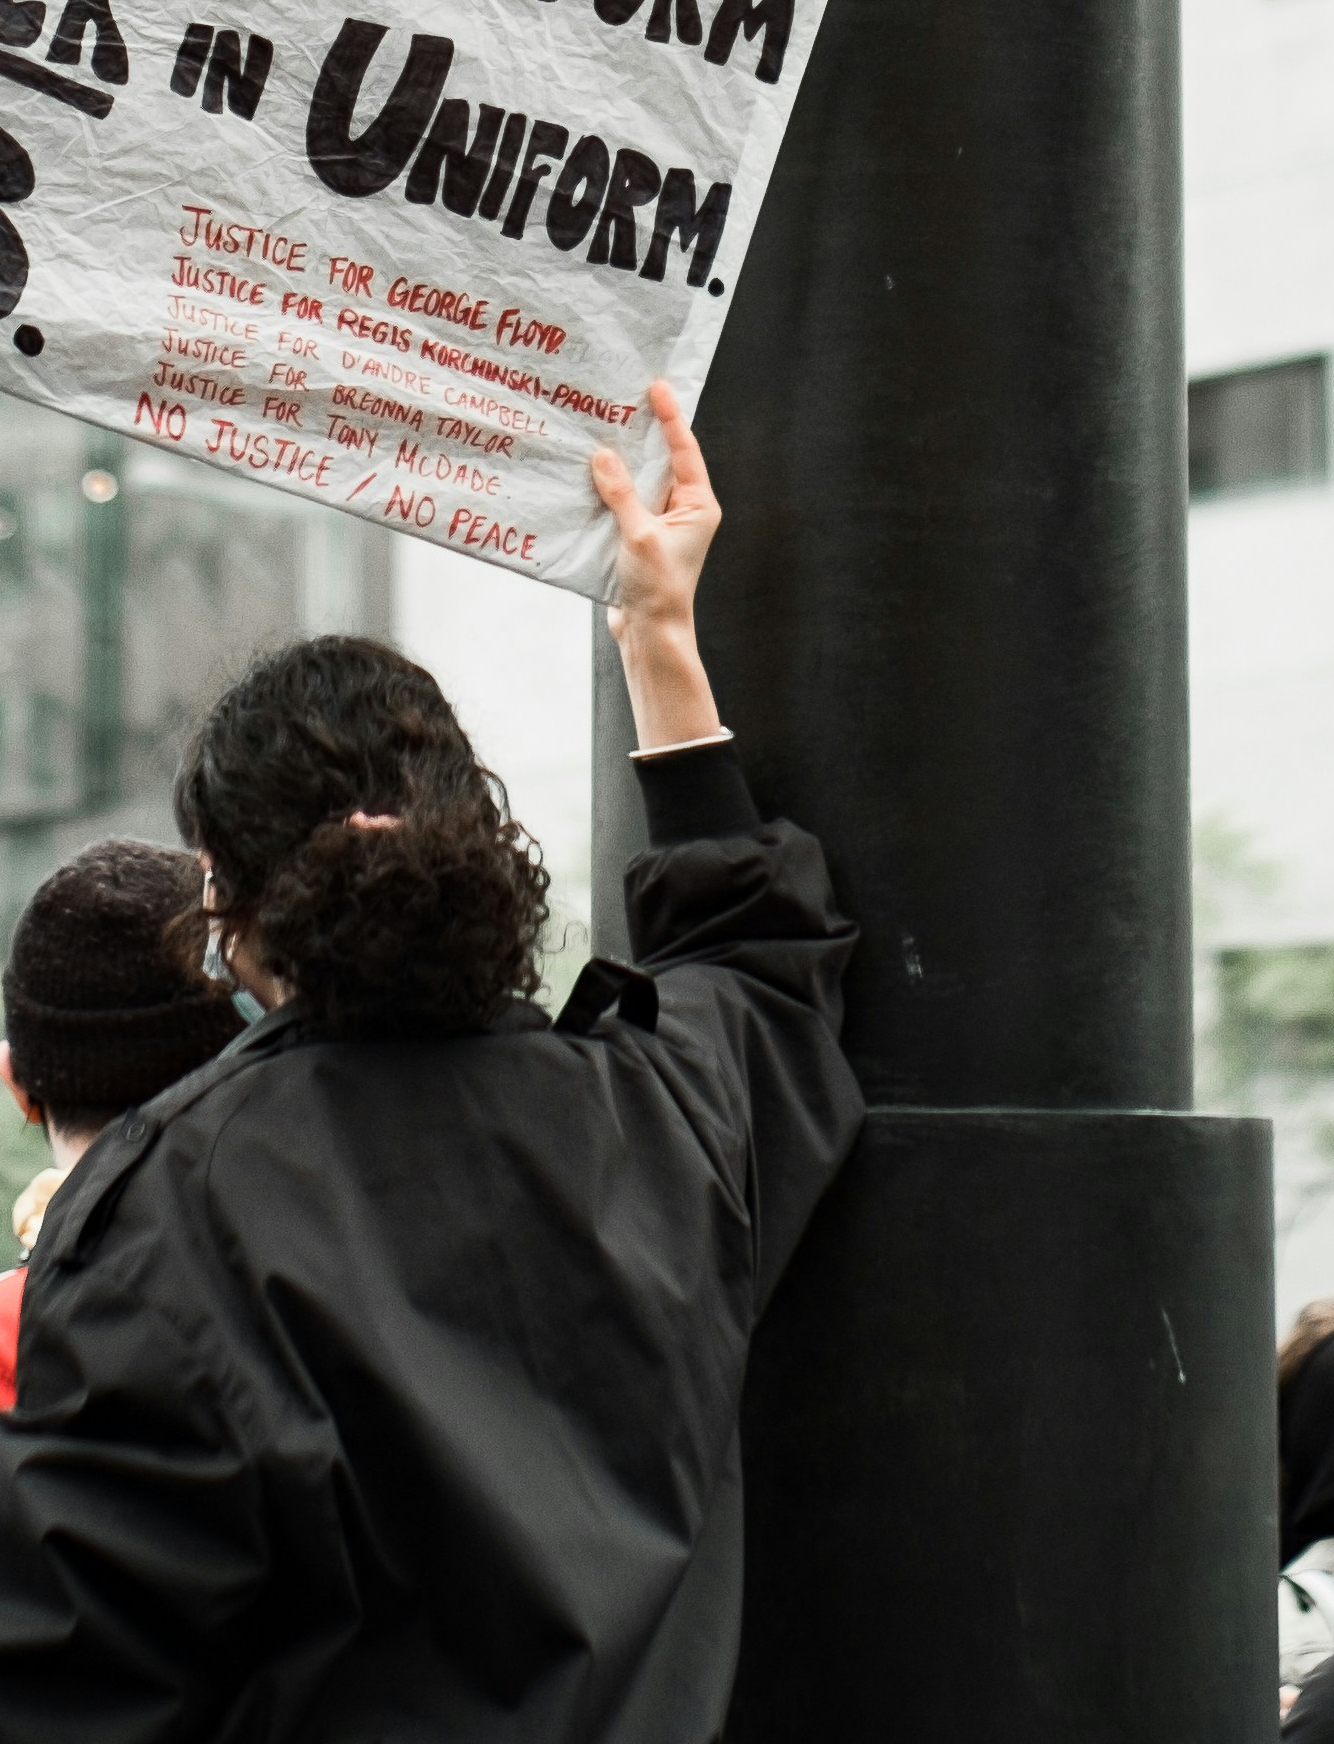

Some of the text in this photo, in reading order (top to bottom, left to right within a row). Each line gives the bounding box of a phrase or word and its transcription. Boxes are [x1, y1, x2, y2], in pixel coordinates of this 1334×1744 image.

[170, 23, 273, 121] IN
[306, 17, 734, 297] UNIFORM.
[171, 256, 267, 306] JUSTICE
[282, 292, 324, 325] FOR
[337, 307, 413, 353] REGIS
[179, 204, 308, 273] JUSTICE
[329, 257, 375, 298] FOR
[386, 276, 490, 331] GEORGE
[161, 327, 248, 369] JUSTICE
[269, 363, 310, 392] FOR
[332, 384, 424, 432] BREONNA
[167, 294, 259, 341] JUSTICE
[278, 331, 320, 361] FOR
[342, 350, 431, 396] D'ANDRE
[134, 391, 188, 441] NO
[205, 418, 335, 487] JUSTICE
[384, 484, 437, 529] NO
[153, 360, 247, 406] JUSTICE
[262, 396, 303, 428] FOR
[328, 413, 379, 458] TONY
